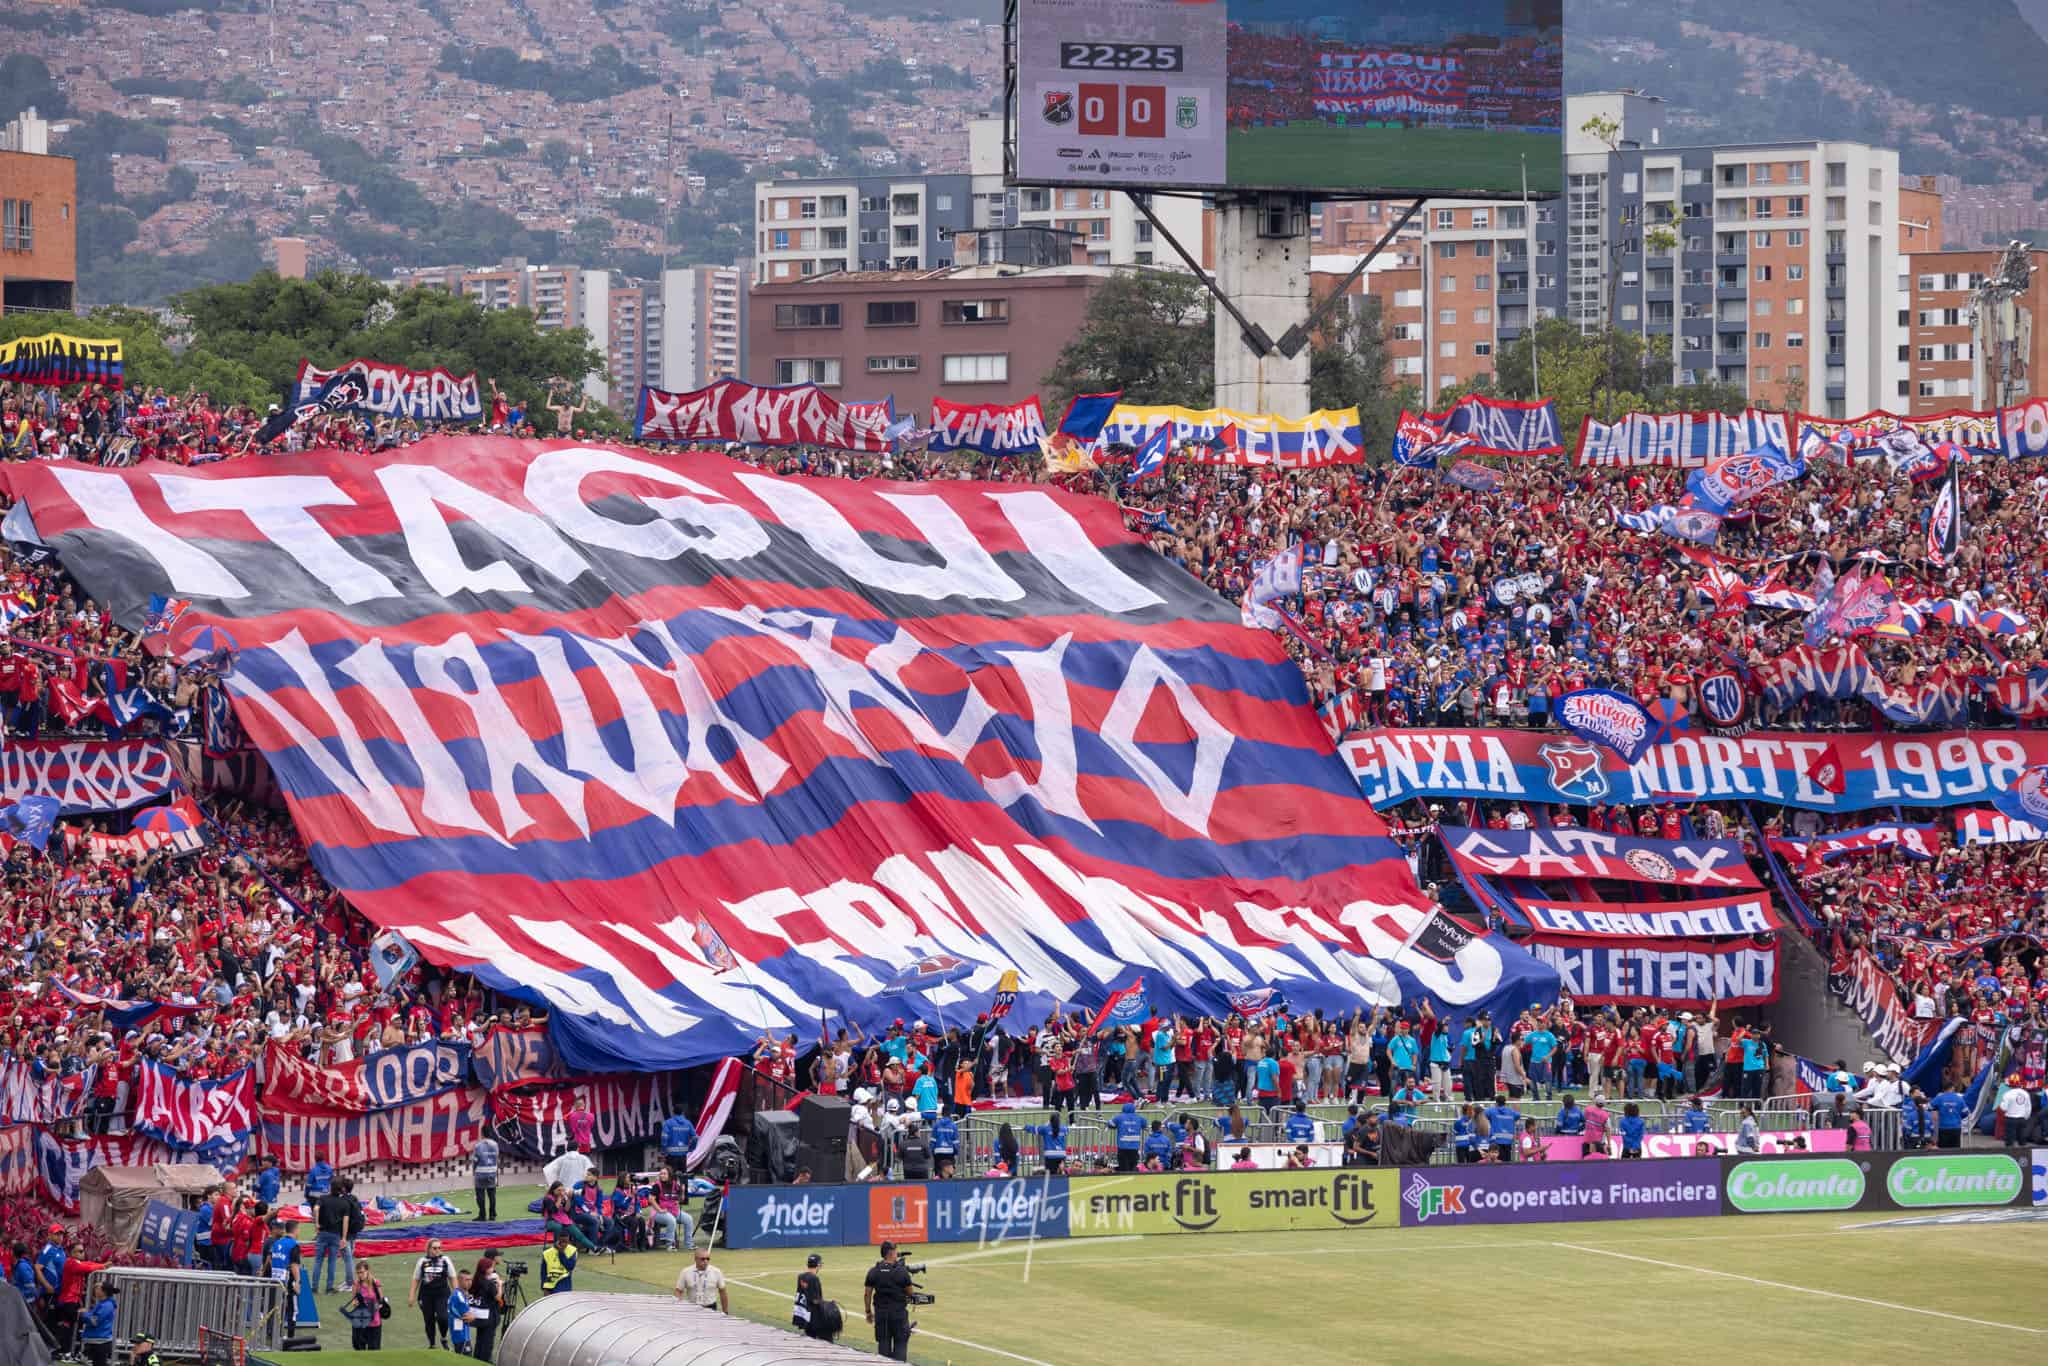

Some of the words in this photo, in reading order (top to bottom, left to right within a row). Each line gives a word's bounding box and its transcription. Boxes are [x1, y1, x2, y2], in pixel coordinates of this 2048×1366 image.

[1067, 44, 1177, 69] 22:25
[1085, 97, 1105, 123] 0
[1131, 98, 1151, 123] 0
[49, 447, 1168, 614] ITAGUI
[1630, 736, 1835, 804] NORTE
[1860, 737, 2027, 801] 1998
[1607, 948, 1776, 998] ETERNO
[1090, 1189, 1170, 1214] smart
[1174, 1178, 1219, 1217] fit
[1249, 1185, 1328, 1209] smart
[1331, 1173, 1376, 1212] fit
[1732, 1170, 1859, 1200] Colanta
[1891, 1166, 2017, 1195] Colanta
[1417, 1184, 1466, 1221] JFK
[1470, 1184, 1603, 1211] Cooperativa
[1609, 1182, 1718, 1204] Financiera
